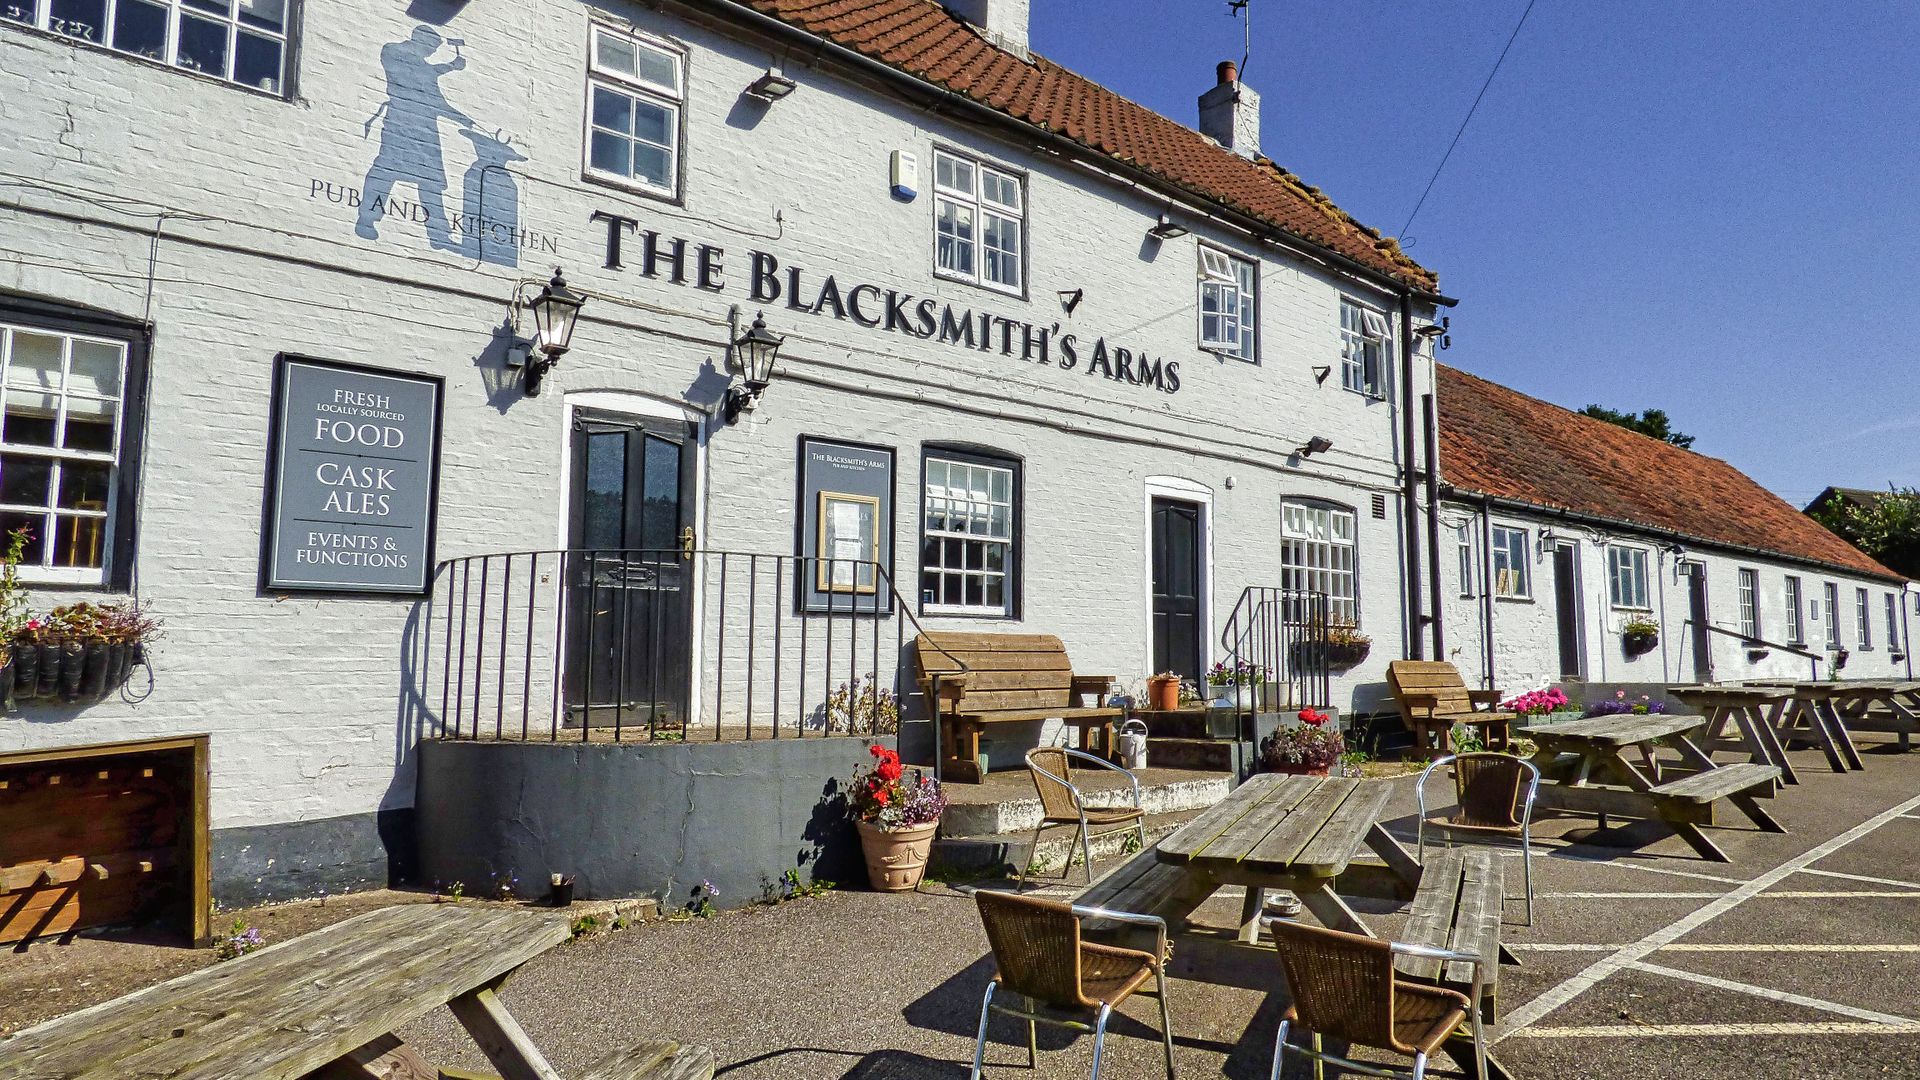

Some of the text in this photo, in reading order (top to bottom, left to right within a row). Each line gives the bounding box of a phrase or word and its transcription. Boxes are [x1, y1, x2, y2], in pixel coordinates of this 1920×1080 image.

[310, 178, 558, 254] PUB AND KITCHEN
[589, 209, 1182, 394] THE BLACKSMITH'S ARMS
[334, 389, 390, 409] FRESH
[317, 403, 405, 421] LOCALLY SOURCED
[314, 418, 404, 448] FOOD
[812, 453, 825, 461] THE
[868, 460, 885, 469] ARMS
[316, 463, 397, 491] CASK
[321, 490, 390, 516] ALES
[307, 532, 397, 550] EVENTS &
[296, 549, 408, 568] FUNCTIONS
